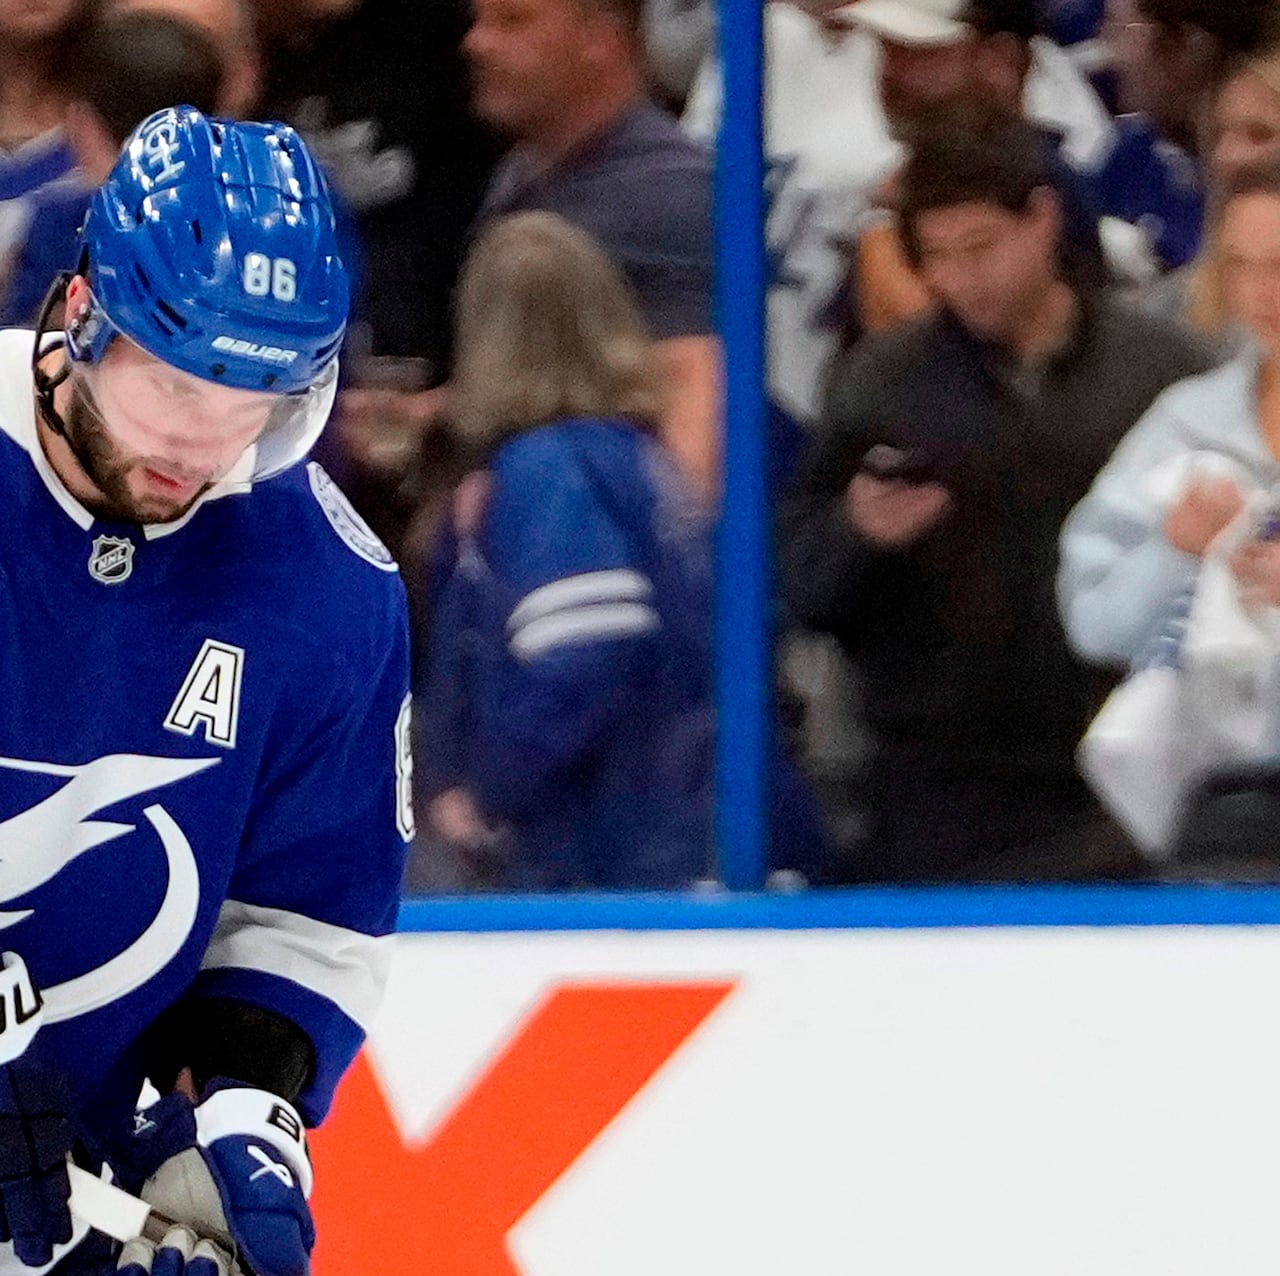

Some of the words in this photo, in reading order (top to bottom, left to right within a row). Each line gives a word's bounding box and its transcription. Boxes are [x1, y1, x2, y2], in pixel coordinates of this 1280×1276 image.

[243, 252, 297, 302] 86
[211, 335, 298, 363] BAUER
[162, 638, 246, 749] A
